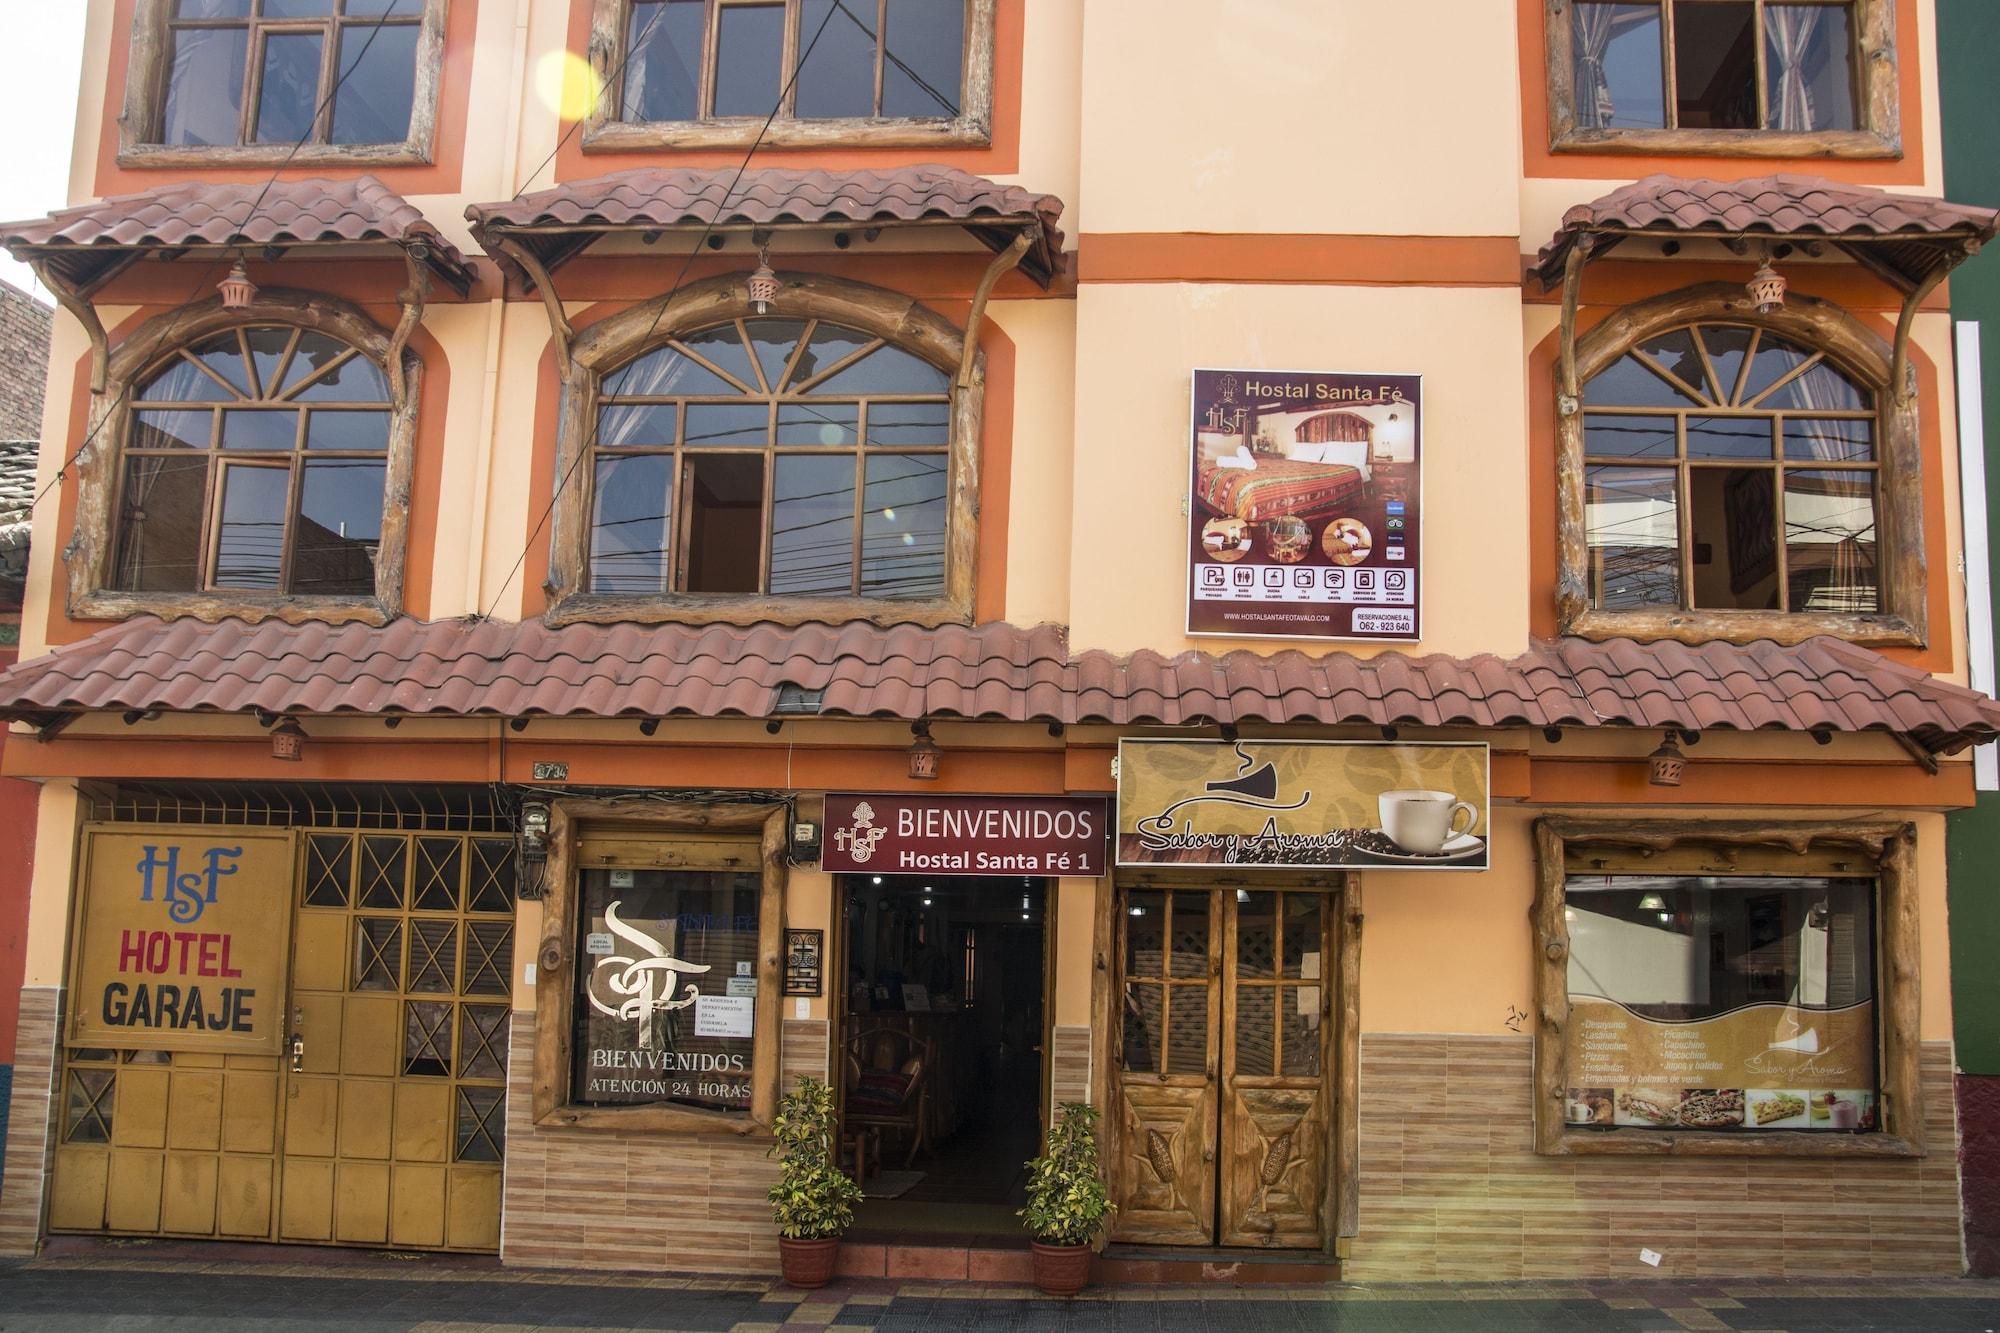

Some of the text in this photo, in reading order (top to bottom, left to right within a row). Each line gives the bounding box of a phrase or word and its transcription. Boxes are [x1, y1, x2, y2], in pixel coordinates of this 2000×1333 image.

[1245, 381, 1403, 401] Hostal Santa Fé
[1224, 613, 1330, 622] WWW.HOSTALSANTAFEOTAVALO.COM
[1357, 613, 1402, 621] RESERVACIONES
[1380, 622, 1394, 631] 923
[1396, 622, 1410, 631] 640
[898, 808, 1092, 839] BIENVENIDOS
[1137, 815, 1224, 850] Sabor
[1225, 834, 1240, 863] y
[900, 851, 1090, 870] Hostal Santa Fé 1
[118, 929, 242, 977] HOTEL
[102, 982, 256, 1032] GARAJE
[1585, 1020, 1627, 1030] Desayunos
[592, 1050, 744, 1072] BIENVENIDOS
[1585, 1052, 1611, 1061] Pizzas
[1585, 1063, 1625, 1072] Ensaladas
[1664, 1061, 1688, 1071] Jugos
[1744, 1057, 1788, 1075] Sabor
[589, 1078, 752, 1098] ATENCIÓN 24 HORAS
[1585, 1074, 1630, 1084] Empanadas
[1669, 1074, 1681, 1083] de
[1681, 1074, 1704, 1083] verde
